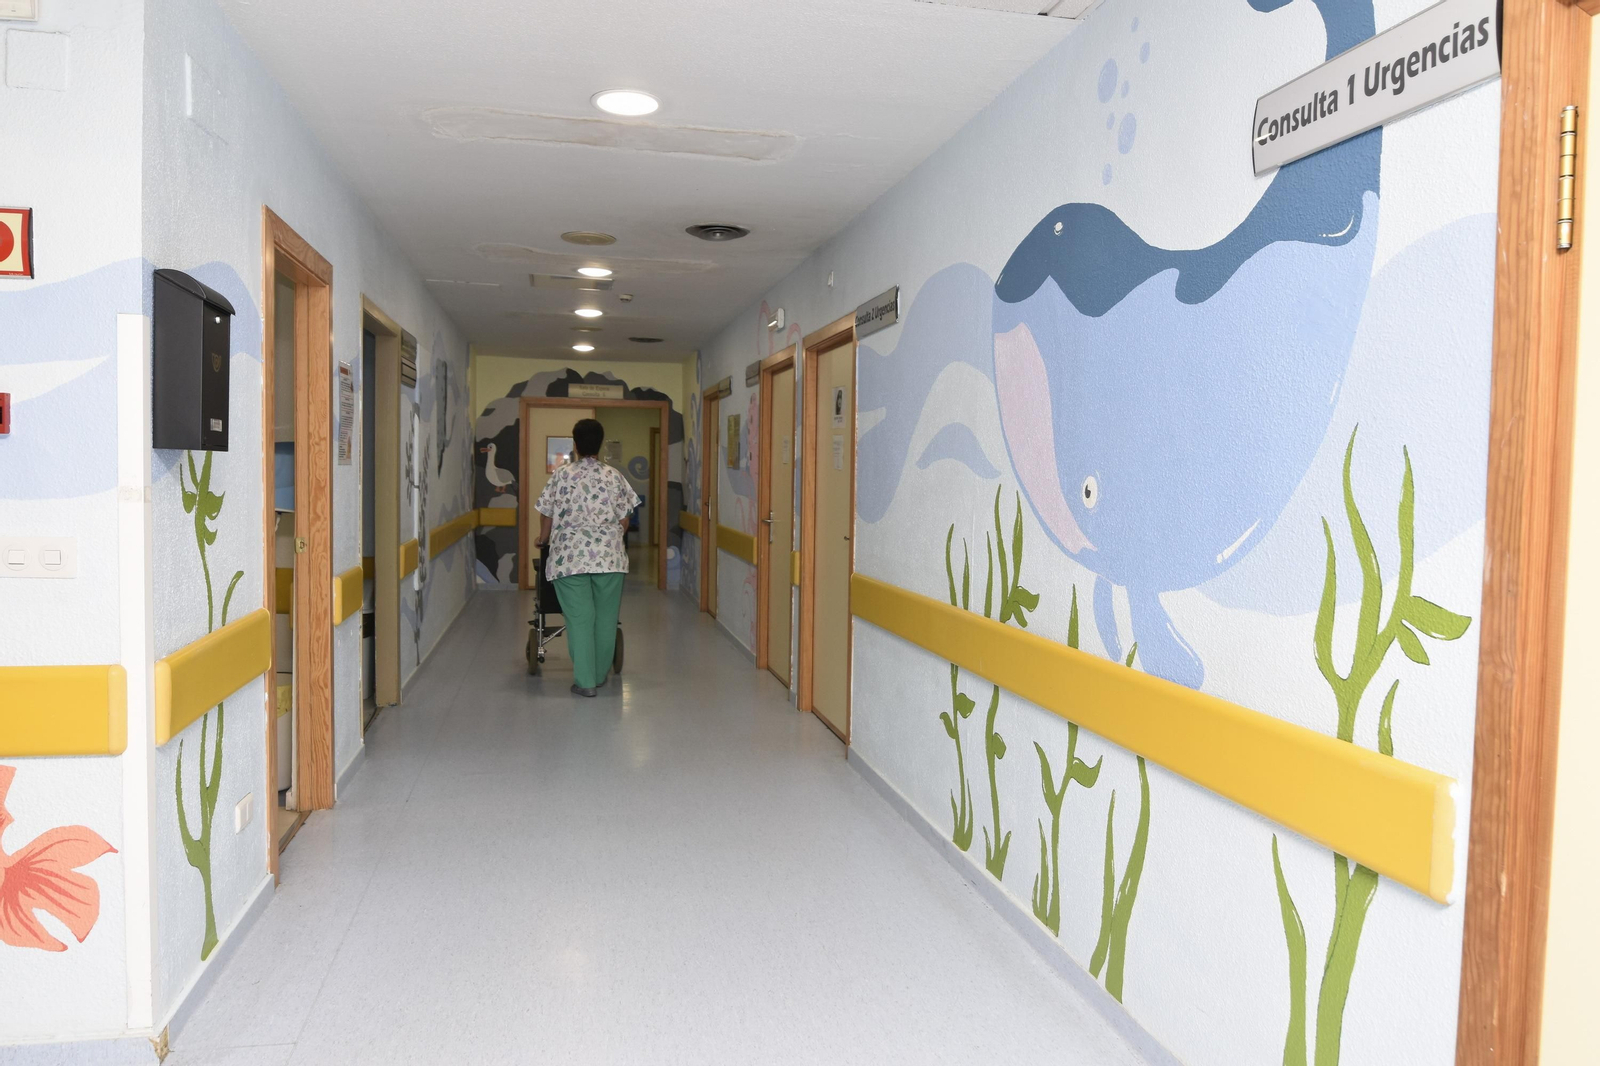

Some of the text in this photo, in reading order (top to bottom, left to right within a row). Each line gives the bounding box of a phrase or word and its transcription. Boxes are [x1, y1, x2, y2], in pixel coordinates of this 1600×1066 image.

[1257, 16, 1490, 146] Consulta 1 Urgencias
[874, 299, 895, 321] Urgencias
